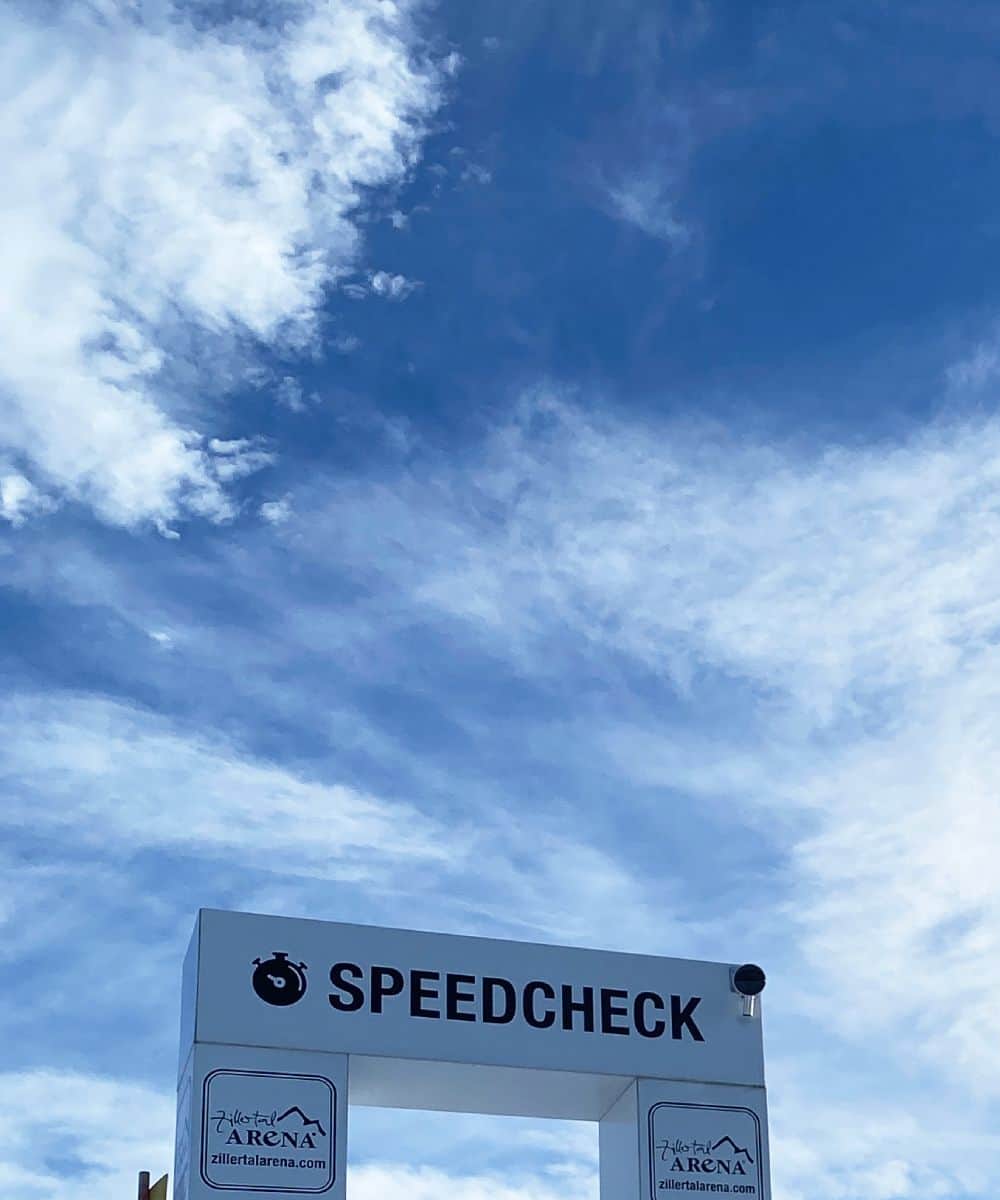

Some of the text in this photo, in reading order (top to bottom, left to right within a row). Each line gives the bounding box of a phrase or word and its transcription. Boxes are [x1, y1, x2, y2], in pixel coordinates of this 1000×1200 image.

[328, 962, 705, 1042] SPEEDCHECK
[211, 1153, 326, 1169] zillertalarena.com
[659, 1179, 755, 1194] zillertalarena.com
